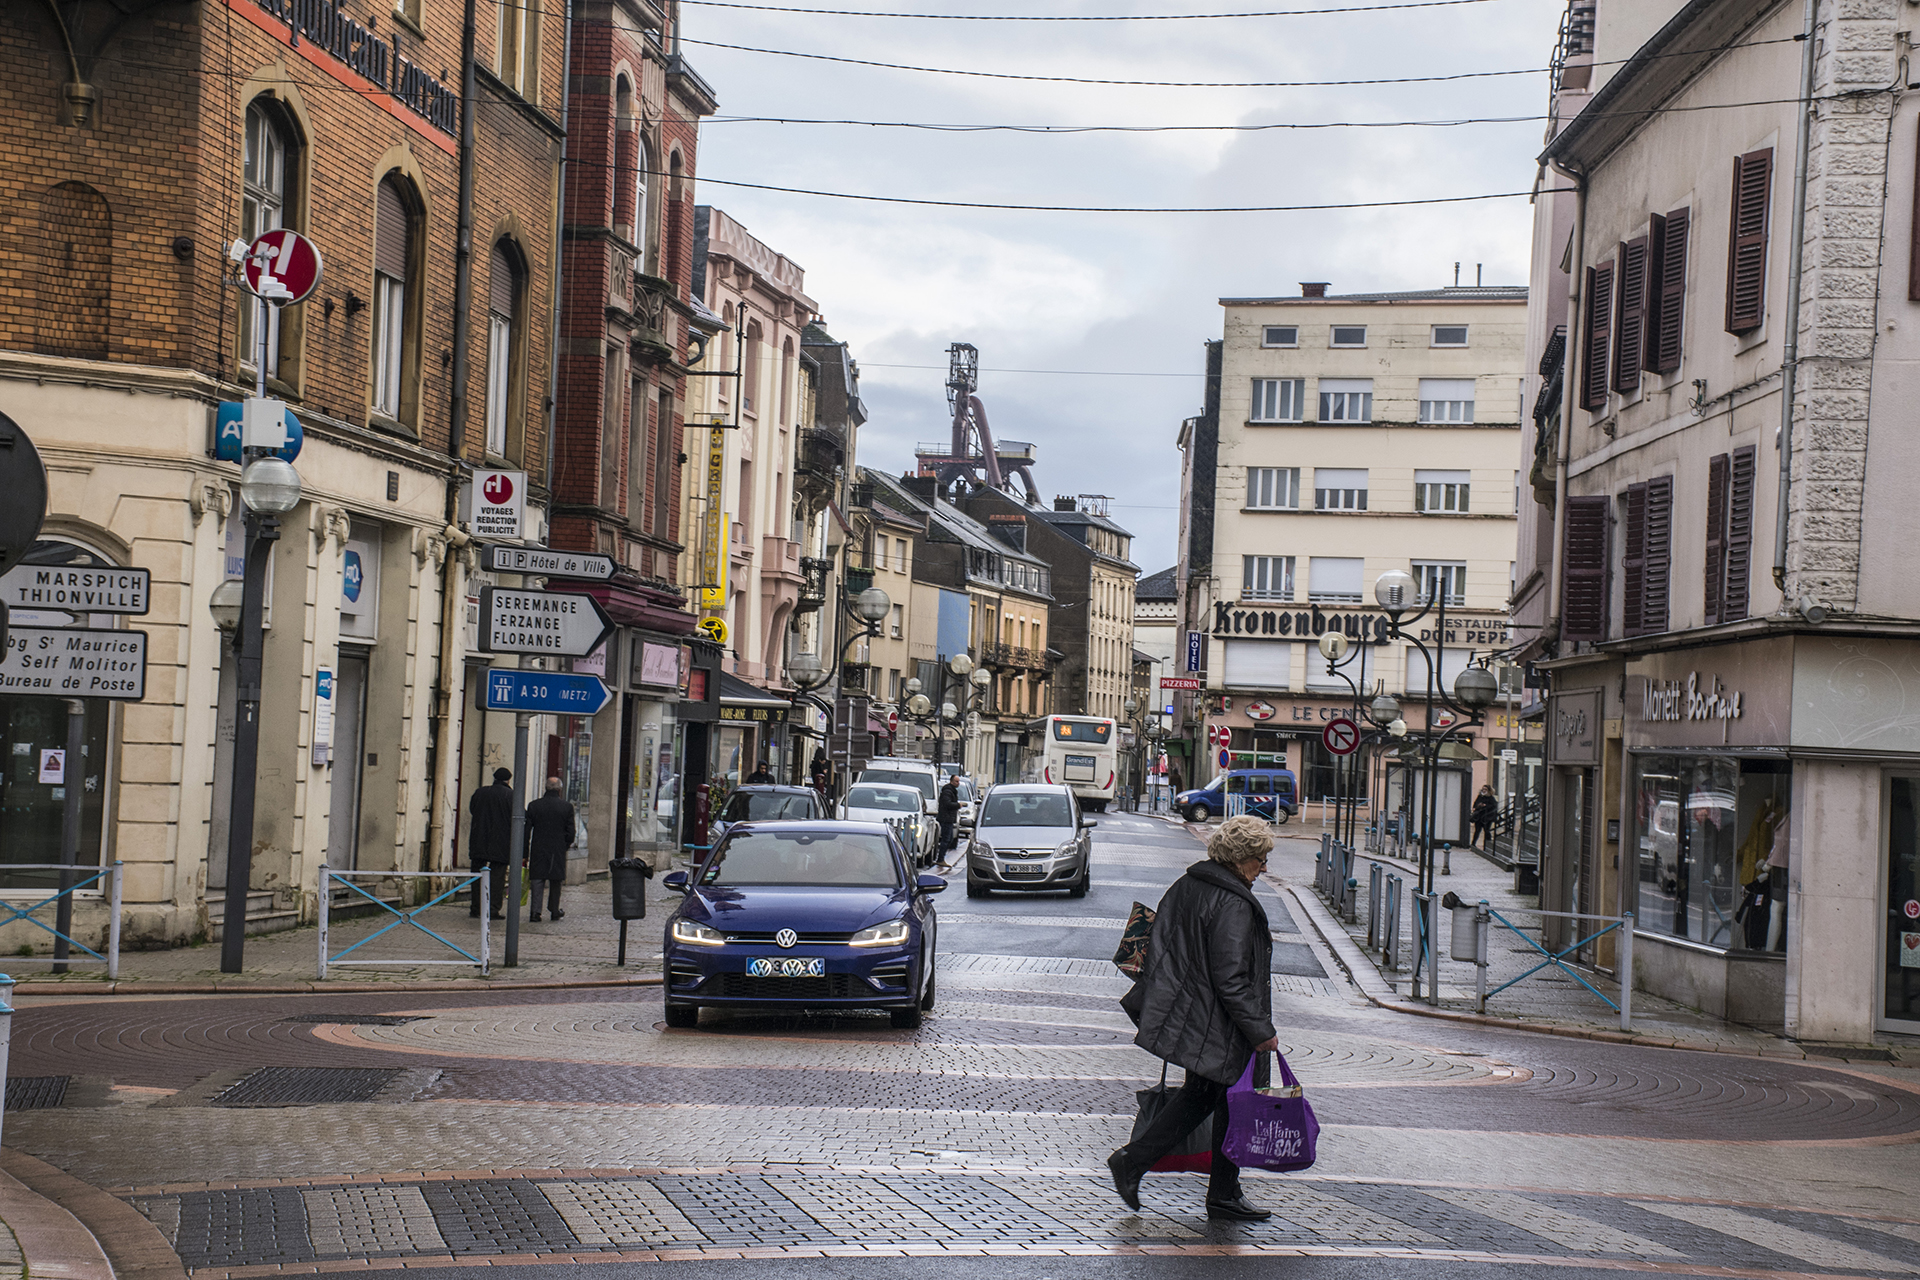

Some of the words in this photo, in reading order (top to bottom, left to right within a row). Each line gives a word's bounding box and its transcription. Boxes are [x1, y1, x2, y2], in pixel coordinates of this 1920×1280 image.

[392, 33, 458, 137] Lorrain
[481, 506, 514, 516] VOYAGES
[476, 516, 517, 525] REDACTION
[477, 525, 515, 535] PUBLICITE
[530, 555, 559, 569] Hôtel
[564, 559, 577, 571] de
[583, 560, 606, 574] Ville
[36, 571, 141, 590] MARSPICH
[19, 587, 141, 607] THIONVILLE
[496, 596, 577, 614] SEREMANGE
[1213, 601, 1389, 645] Kronenbourg
[66, 637, 138, 653] Maurice
[493, 632, 561, 648] FLORANGE
[1421, 629, 1456, 643] DON
[1191, 634, 1199, 670] HOTEL
[21, 654, 60, 669] Self
[69, 656, 138, 672] Molitor
[0, 672, 52, 688] Bureau
[61, 676, 80, 689] de
[89, 676, 136, 691] Poste
[1161, 680, 1197, 688] PIZZERIA
[520, 685, 528, 697] A
[532, 686, 548, 698] 30
[558, 689, 591, 701] (METZ)
[1292, 706, 1312, 720] LE
[1687, 671, 1741, 744] Boutique
[1096, 726, 1106, 734] 47
[1255, 1119, 1300, 1142] L'affaire
[1274, 1138, 1302, 1157] SAC
